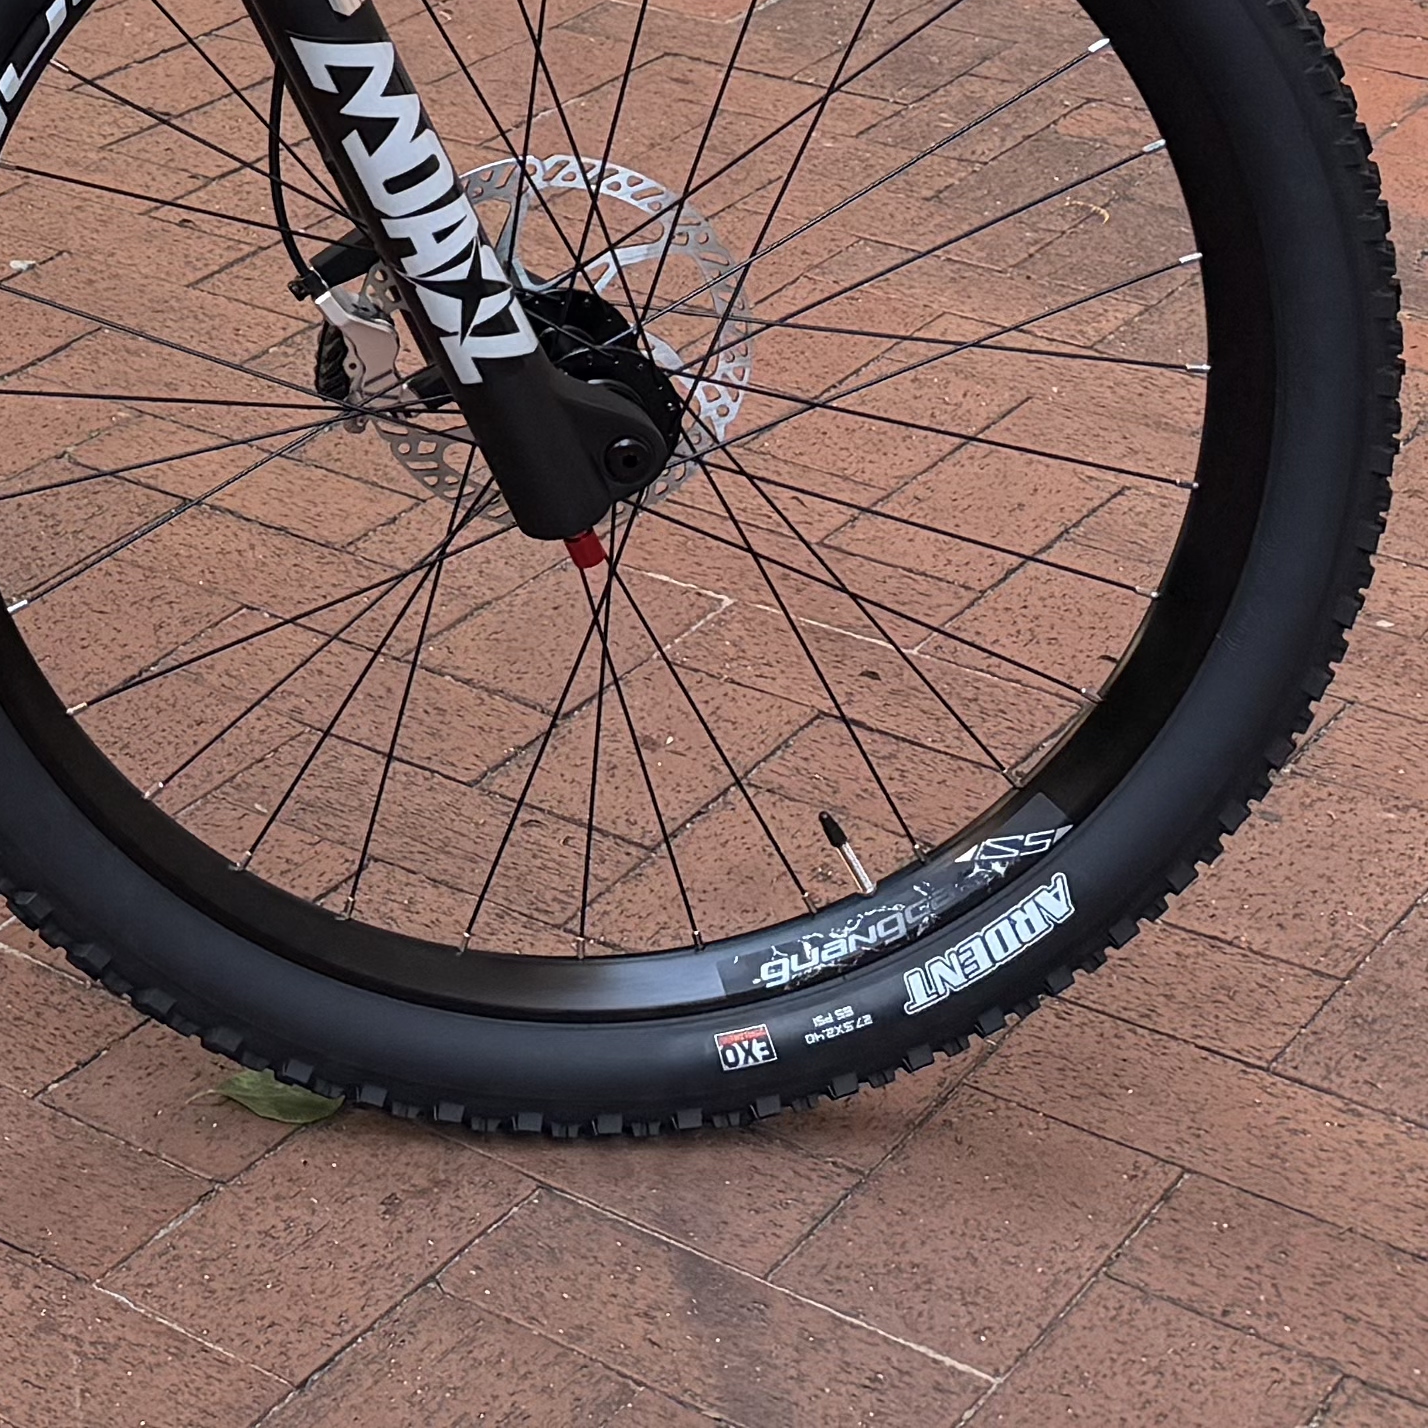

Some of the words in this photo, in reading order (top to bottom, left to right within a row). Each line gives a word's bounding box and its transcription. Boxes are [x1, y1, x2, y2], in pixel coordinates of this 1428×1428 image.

[905, 872, 1076, 1015] ARDENT
[804, 1013, 874, 1045] 27.5X2.40
[812, 1011, 835, 1028] PSI
[720, 1038, 776, 1070] EXO
